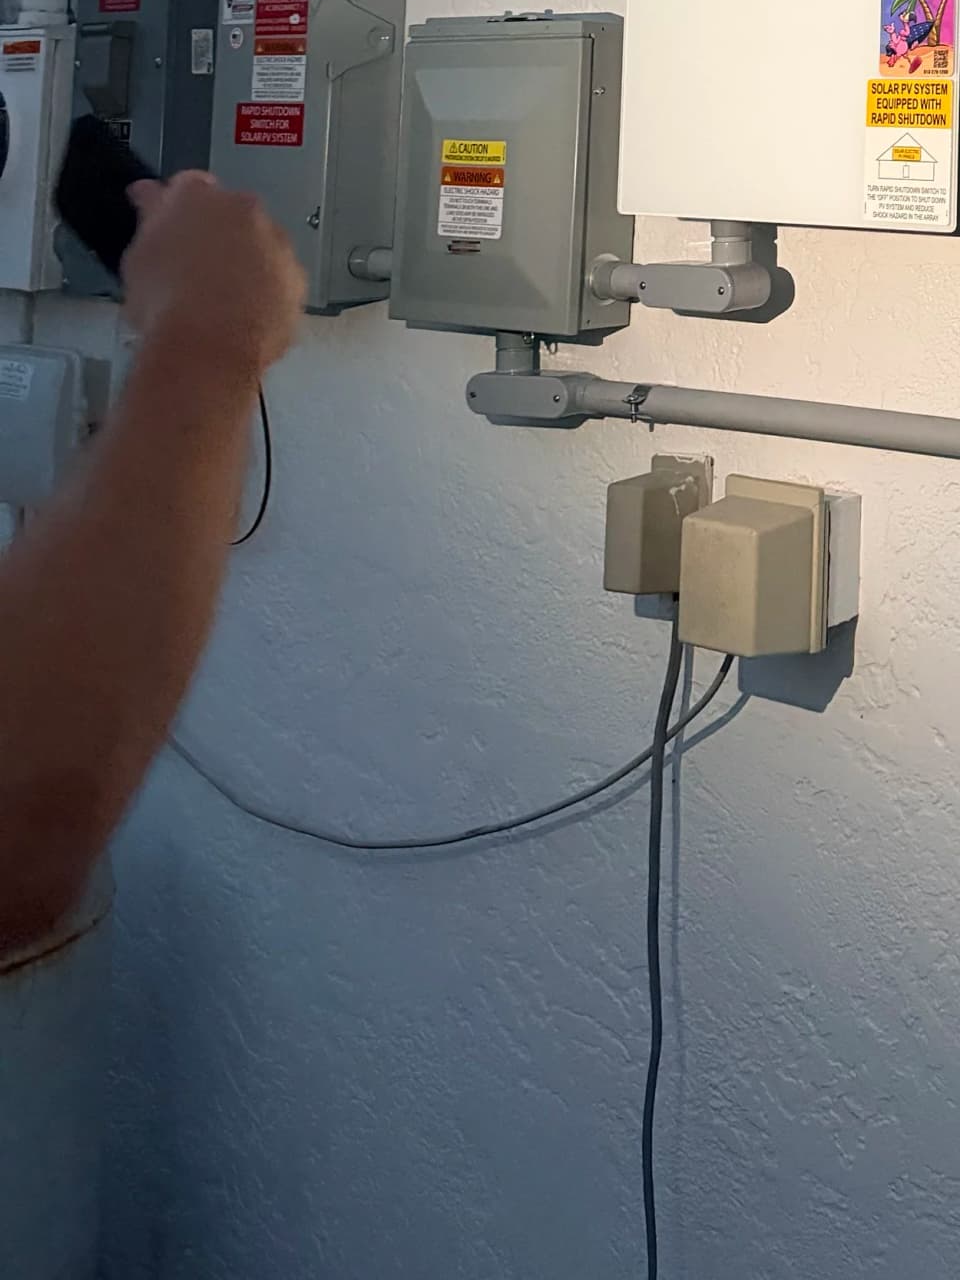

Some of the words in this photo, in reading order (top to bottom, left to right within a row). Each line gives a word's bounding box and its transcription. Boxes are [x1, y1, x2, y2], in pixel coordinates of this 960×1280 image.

[872, 83, 899, 94] SOLAR
[901, 84, 912, 94] PV
[914, 84, 948, 95] SYSTEM
[877, 98, 918, 110] EQUIPPED
[920, 98, 942, 110] WITH
[871, 113, 896, 124] RAPID
[898, 113, 946, 126] SHUTDOWN
[458, 144, 488, 154] CAUTION
[453, 172, 492, 184] WARNING
